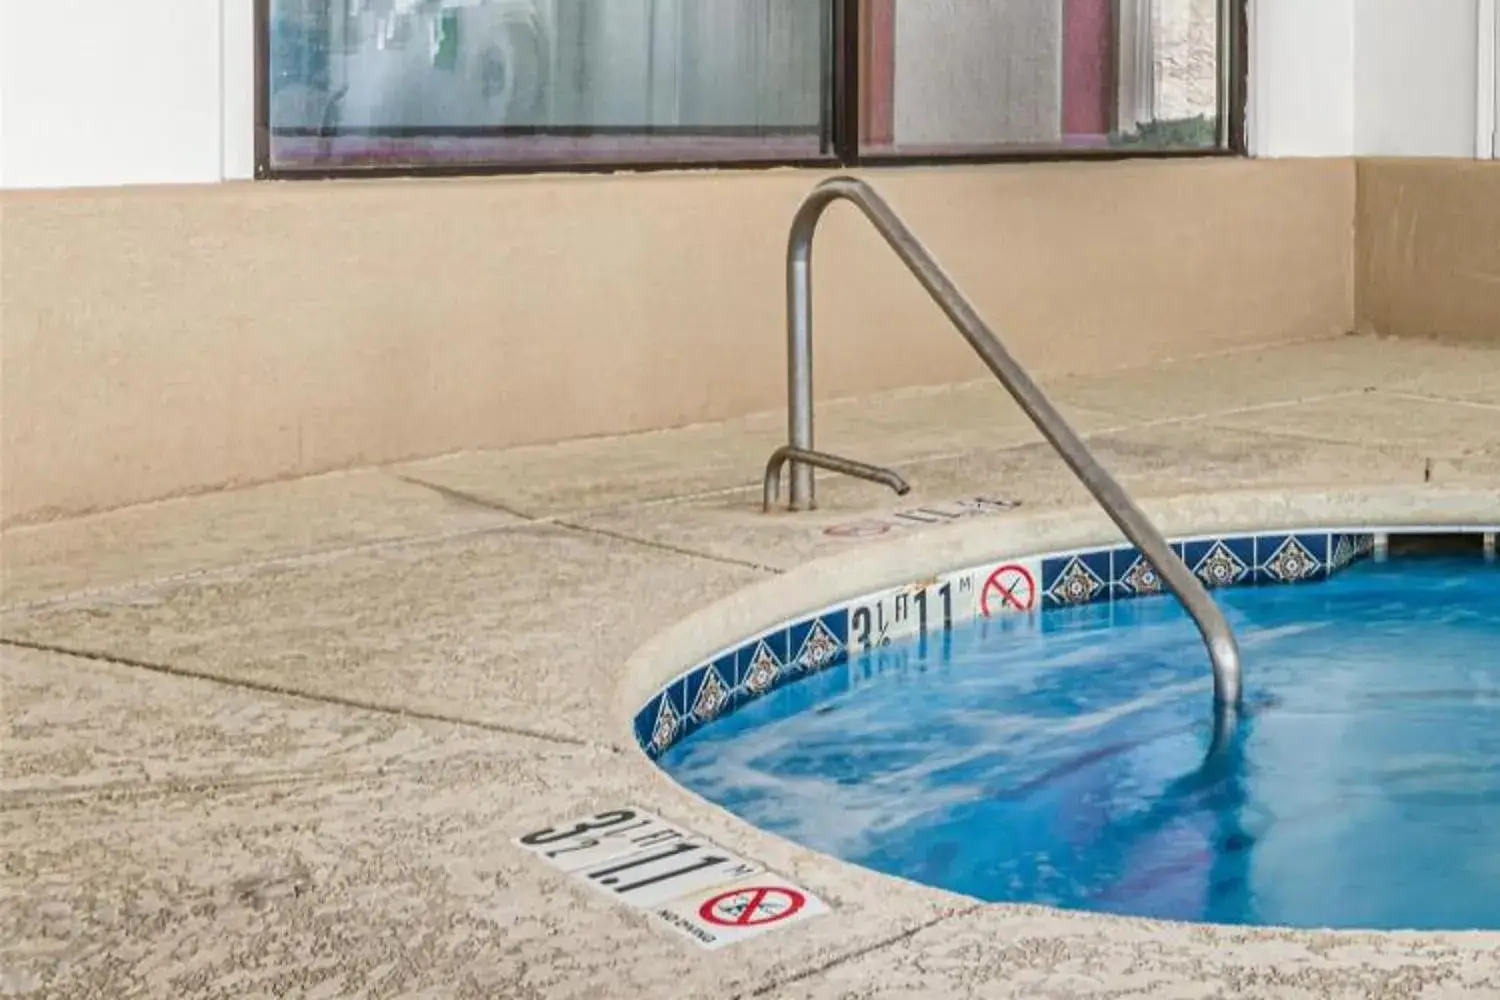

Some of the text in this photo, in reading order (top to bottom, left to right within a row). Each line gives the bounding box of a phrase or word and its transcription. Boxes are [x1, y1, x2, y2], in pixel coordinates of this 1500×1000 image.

[895, 593, 909, 623] FT
[959, 575, 972, 592] M
[587, 842, 729, 893] 1.1
